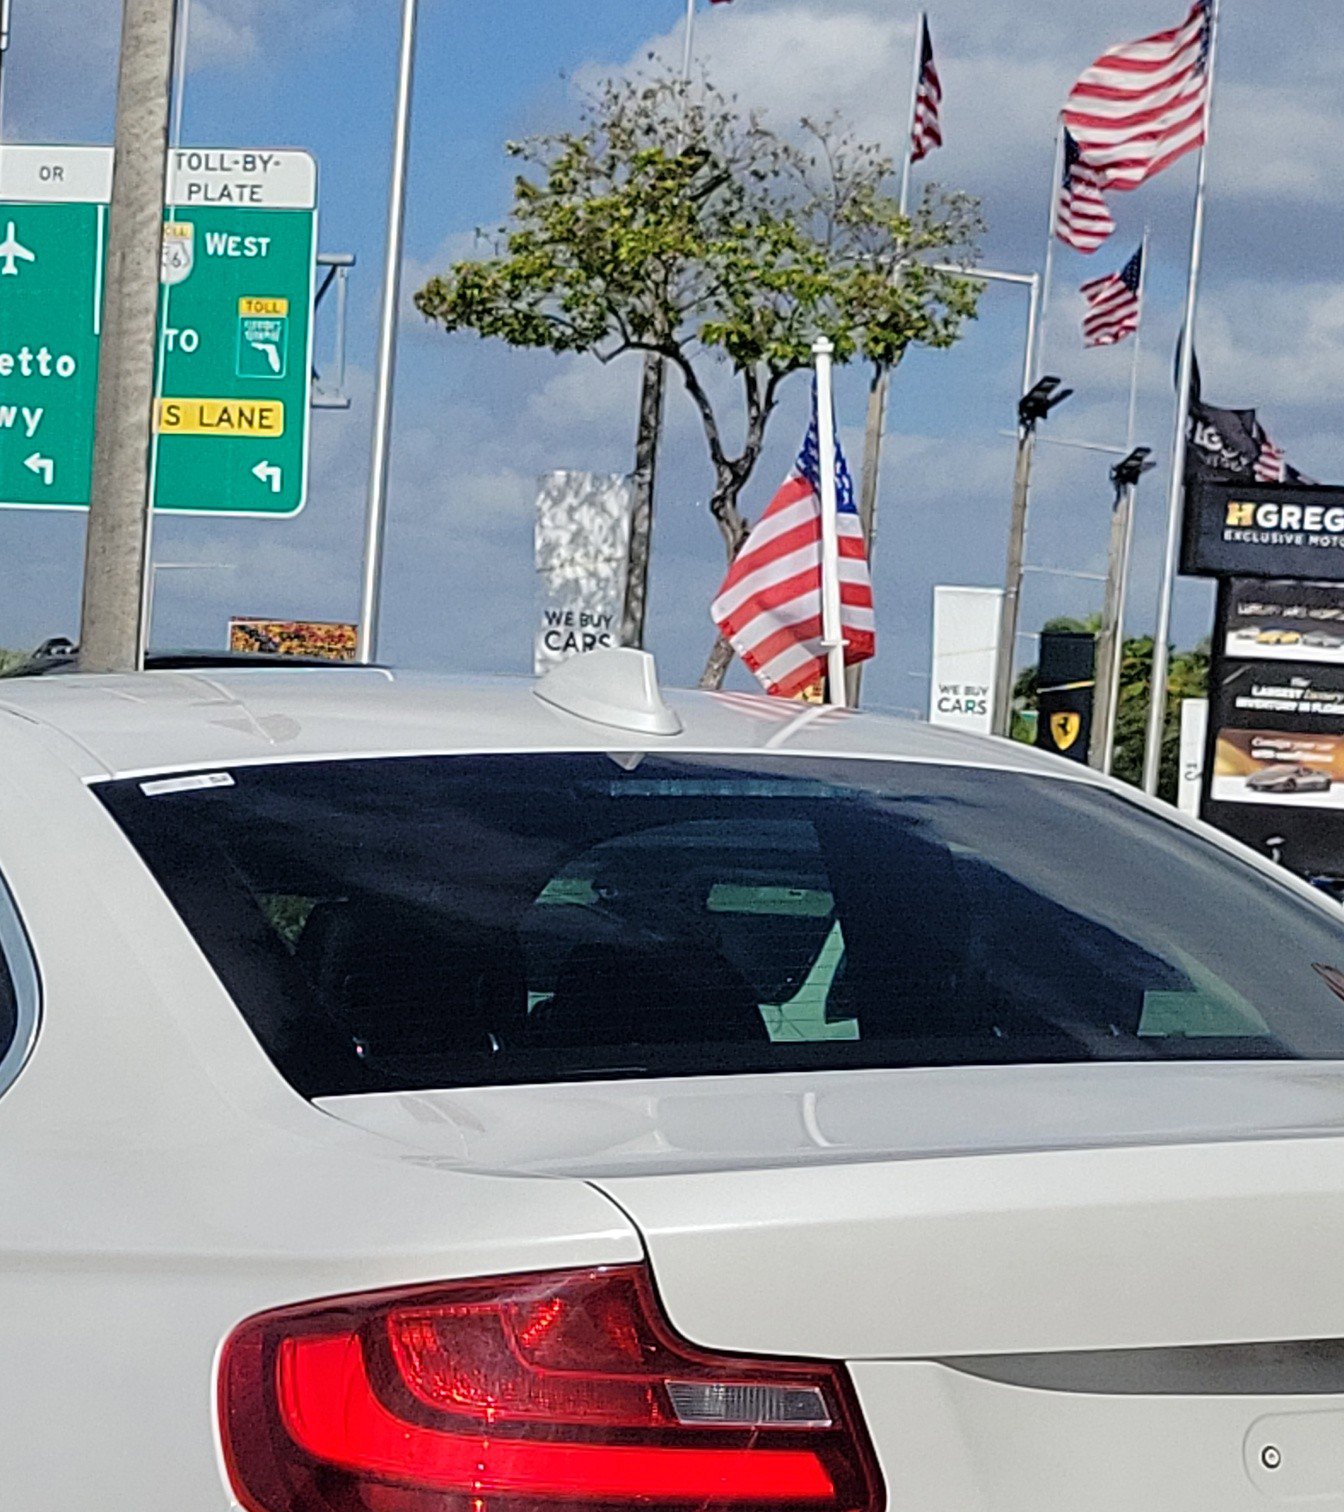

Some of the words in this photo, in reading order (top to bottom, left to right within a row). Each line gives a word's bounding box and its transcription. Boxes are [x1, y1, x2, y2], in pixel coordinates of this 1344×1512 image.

[175, 152, 281, 173] TOLL-BY-
[39, 166, 64, 181] OR
[187, 183, 263, 202] PLATE
[205, 232, 270, 257] WEST
[245, 300, 280, 314] TOLL
[164, 328, 199, 353] TO
[199, 406, 274, 429] LANE
[1223, 529, 1304, 546] EXCLUSIVE
[544, 610, 574, 626] WE
[579, 612, 614, 631] BUY
[544, 629, 611, 653] CARS
[939, 683, 960, 696] WE
[964, 686, 990, 697] BUY
[937, 697, 987, 715] CARS
